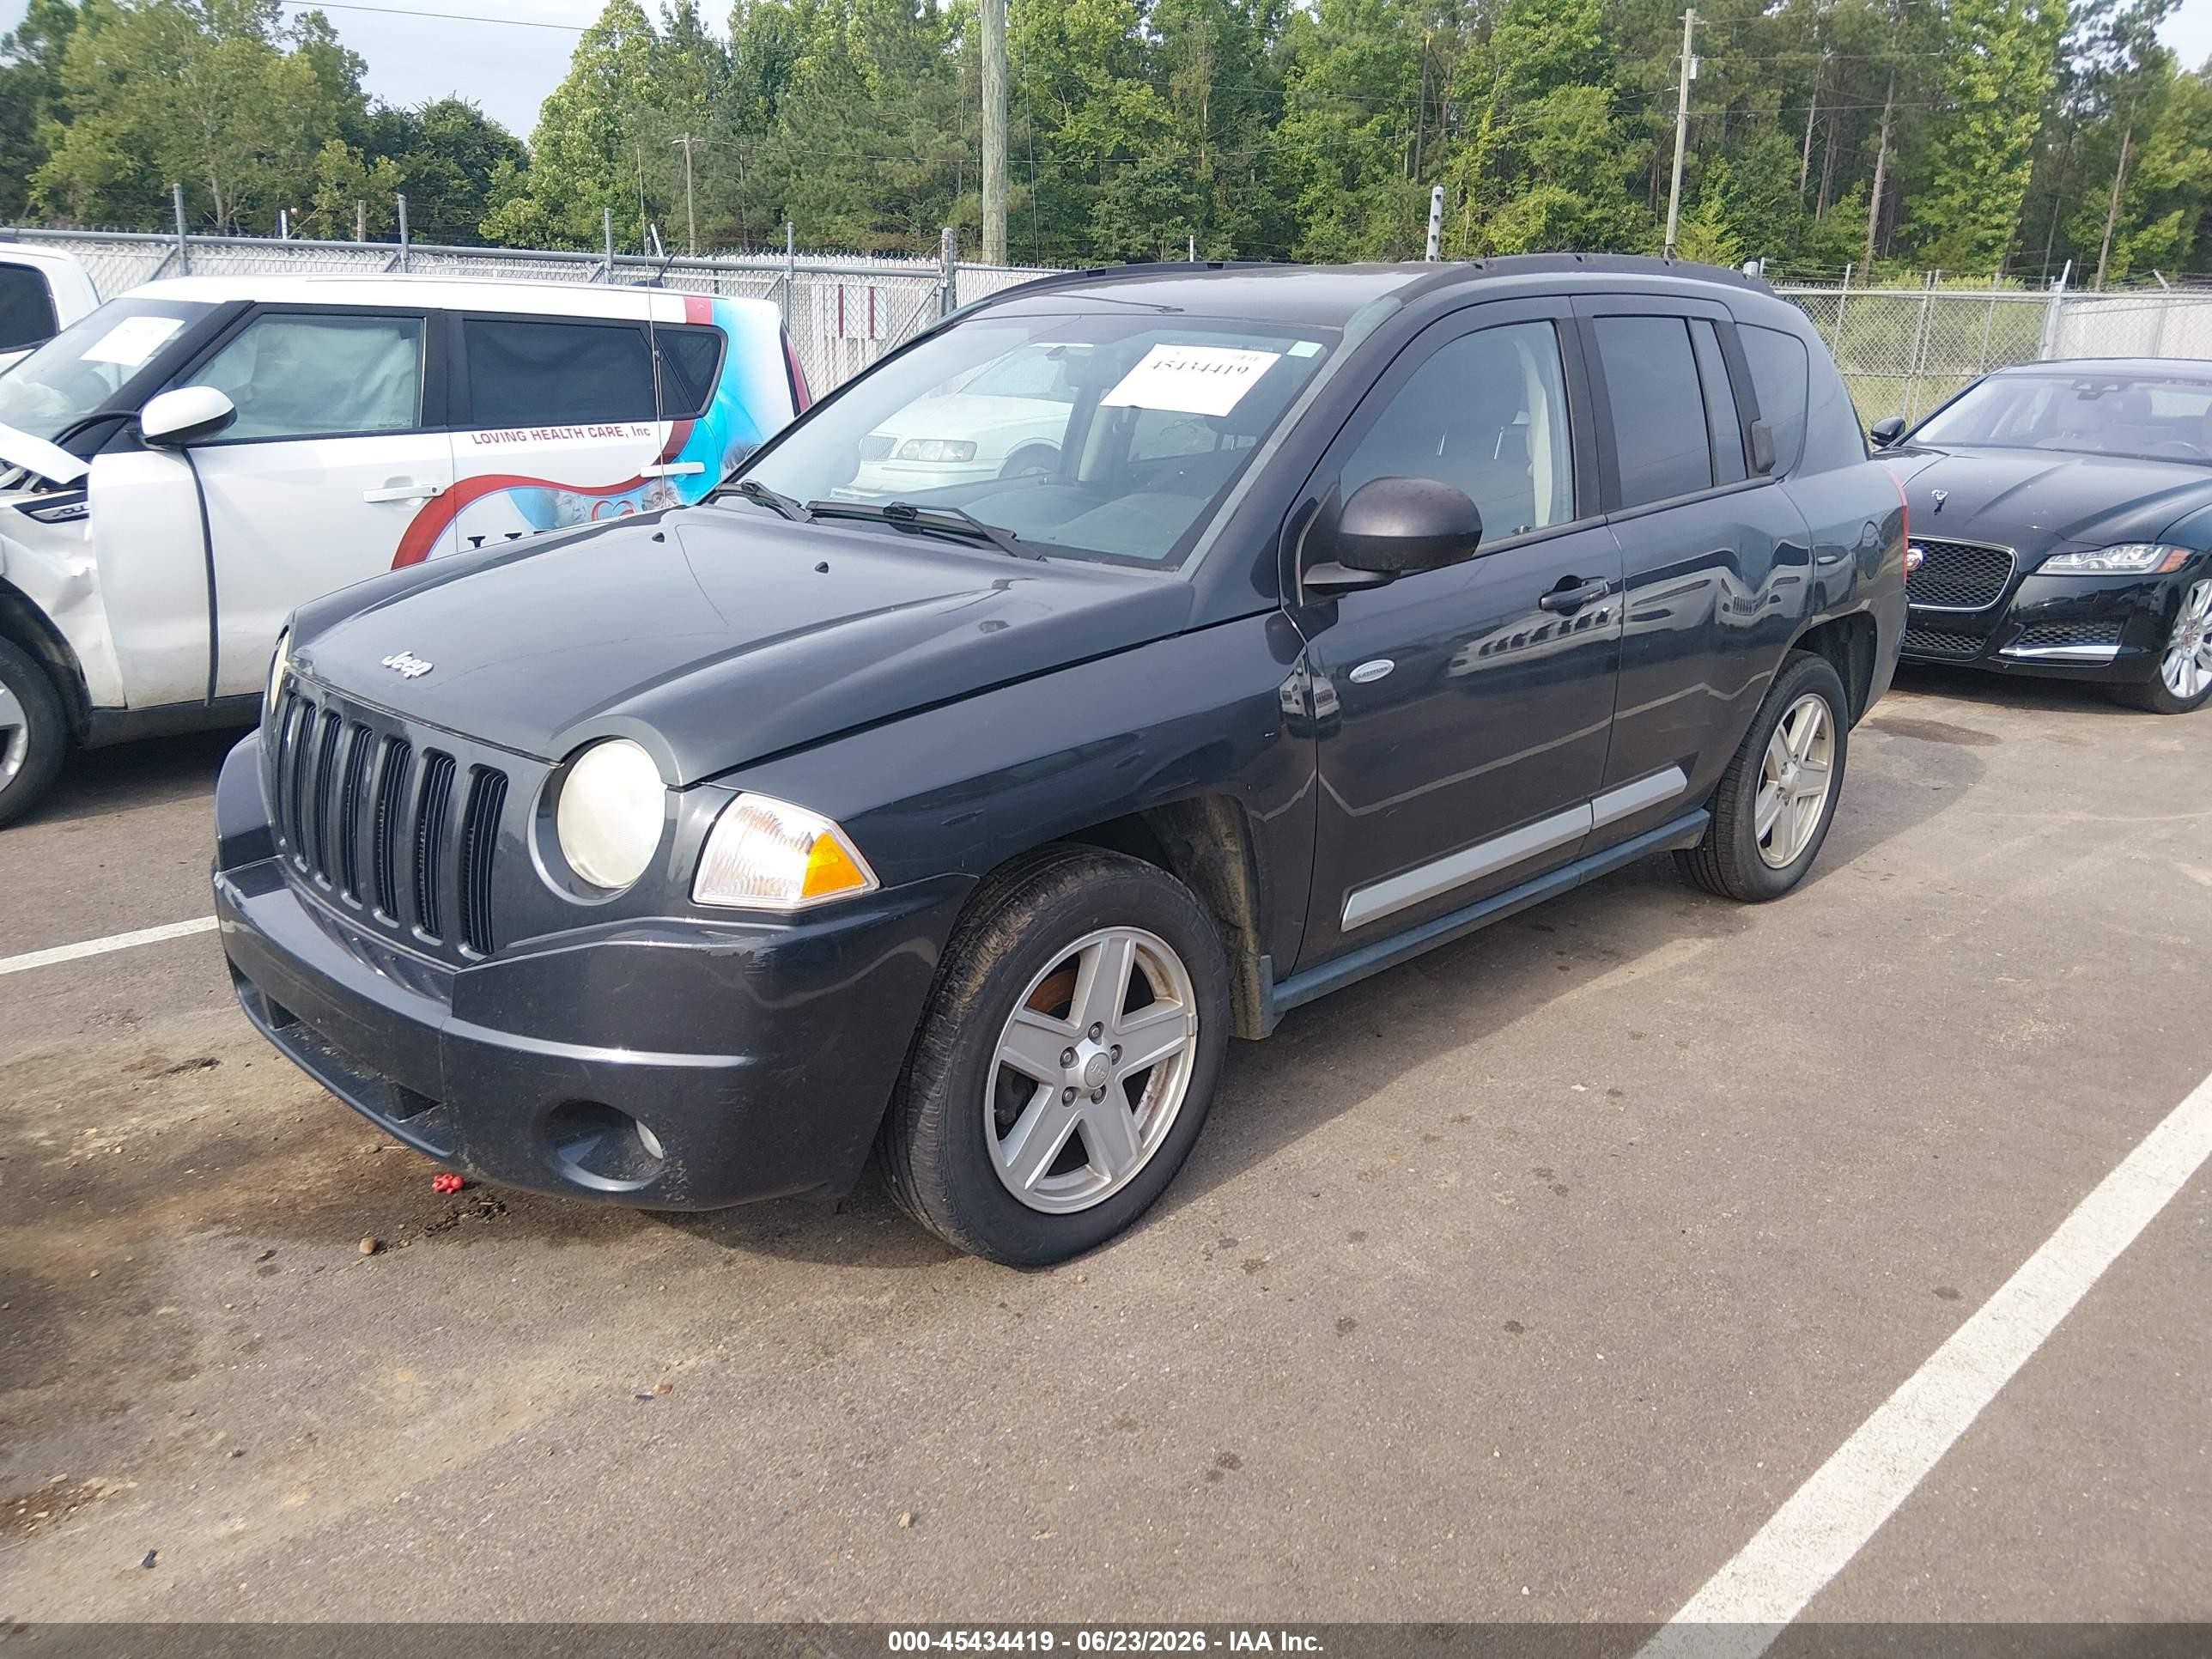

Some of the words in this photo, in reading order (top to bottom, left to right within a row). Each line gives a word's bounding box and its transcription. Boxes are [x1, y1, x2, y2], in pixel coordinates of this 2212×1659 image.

[471, 431, 527, 445] LOVING
[530, 428, 585, 441] HEALTH
[587, 426, 629, 439] CARE,
[630, 425, 651, 437] Inc
[381, 651, 434, 678] Jeep
